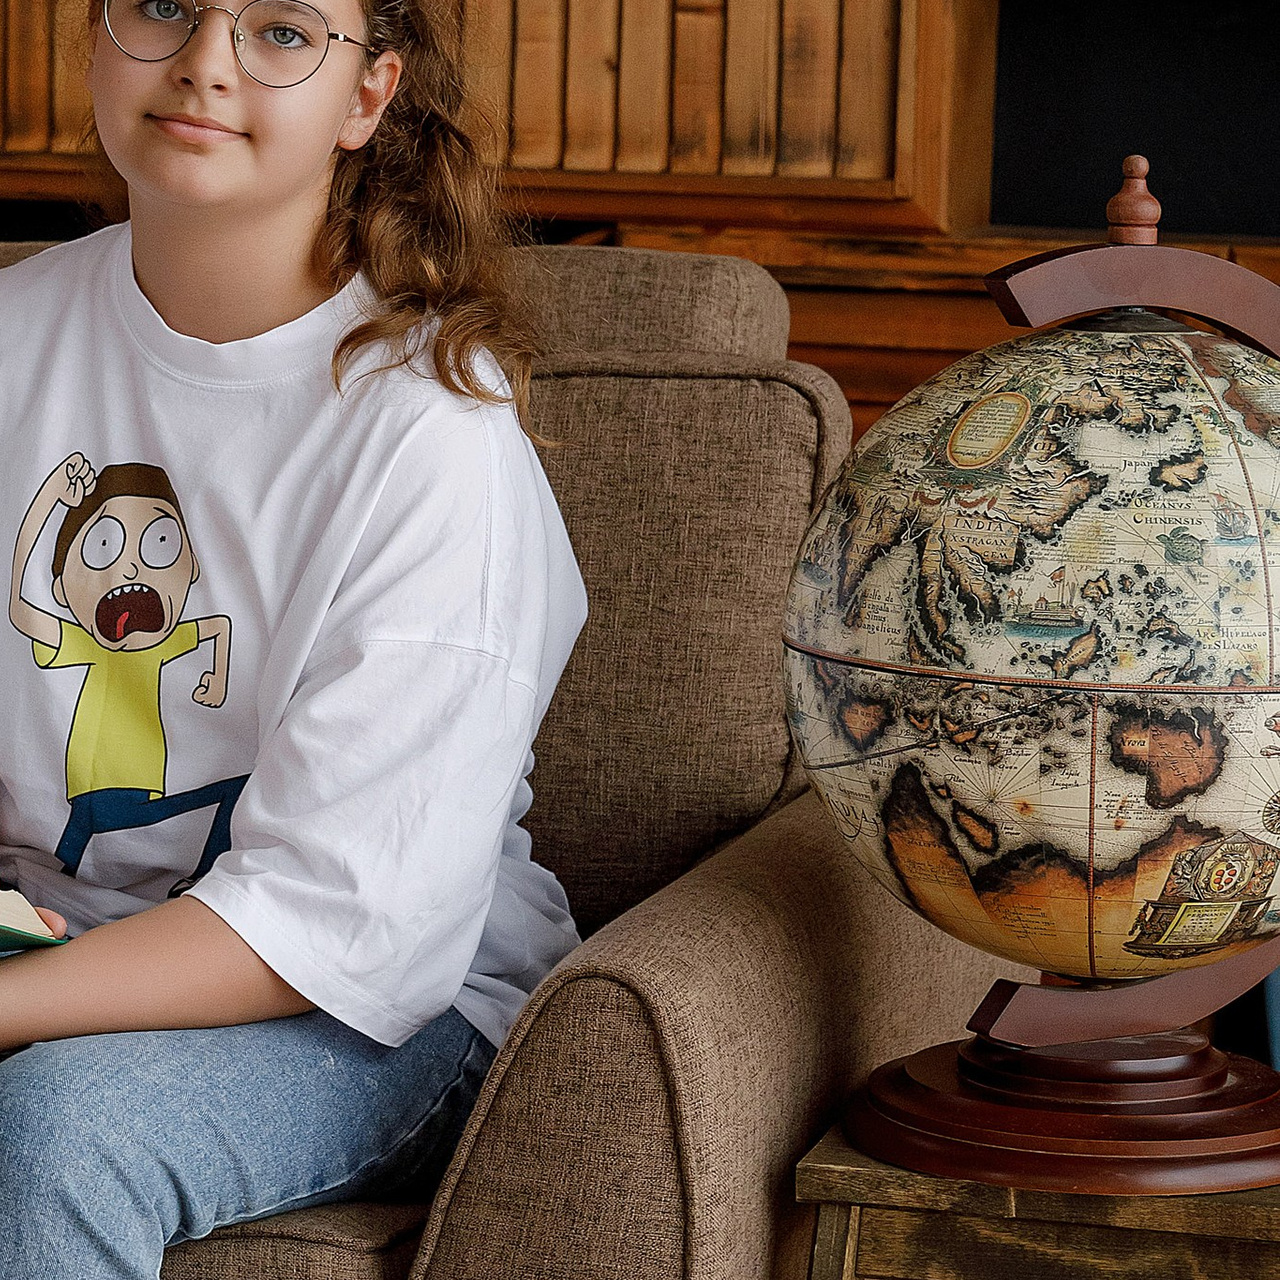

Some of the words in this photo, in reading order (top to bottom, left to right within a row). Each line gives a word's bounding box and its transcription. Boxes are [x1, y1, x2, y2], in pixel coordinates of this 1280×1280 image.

[1121, 459, 1154, 472] Japan
[1134, 497, 1192, 510] OCEANVS
[954, 518, 1004, 532] INDIA
[1133, 513, 1203, 526] CHINENSIS
[862, 600, 890, 614] Bengala
[865, 611, 888, 624] Sinus
